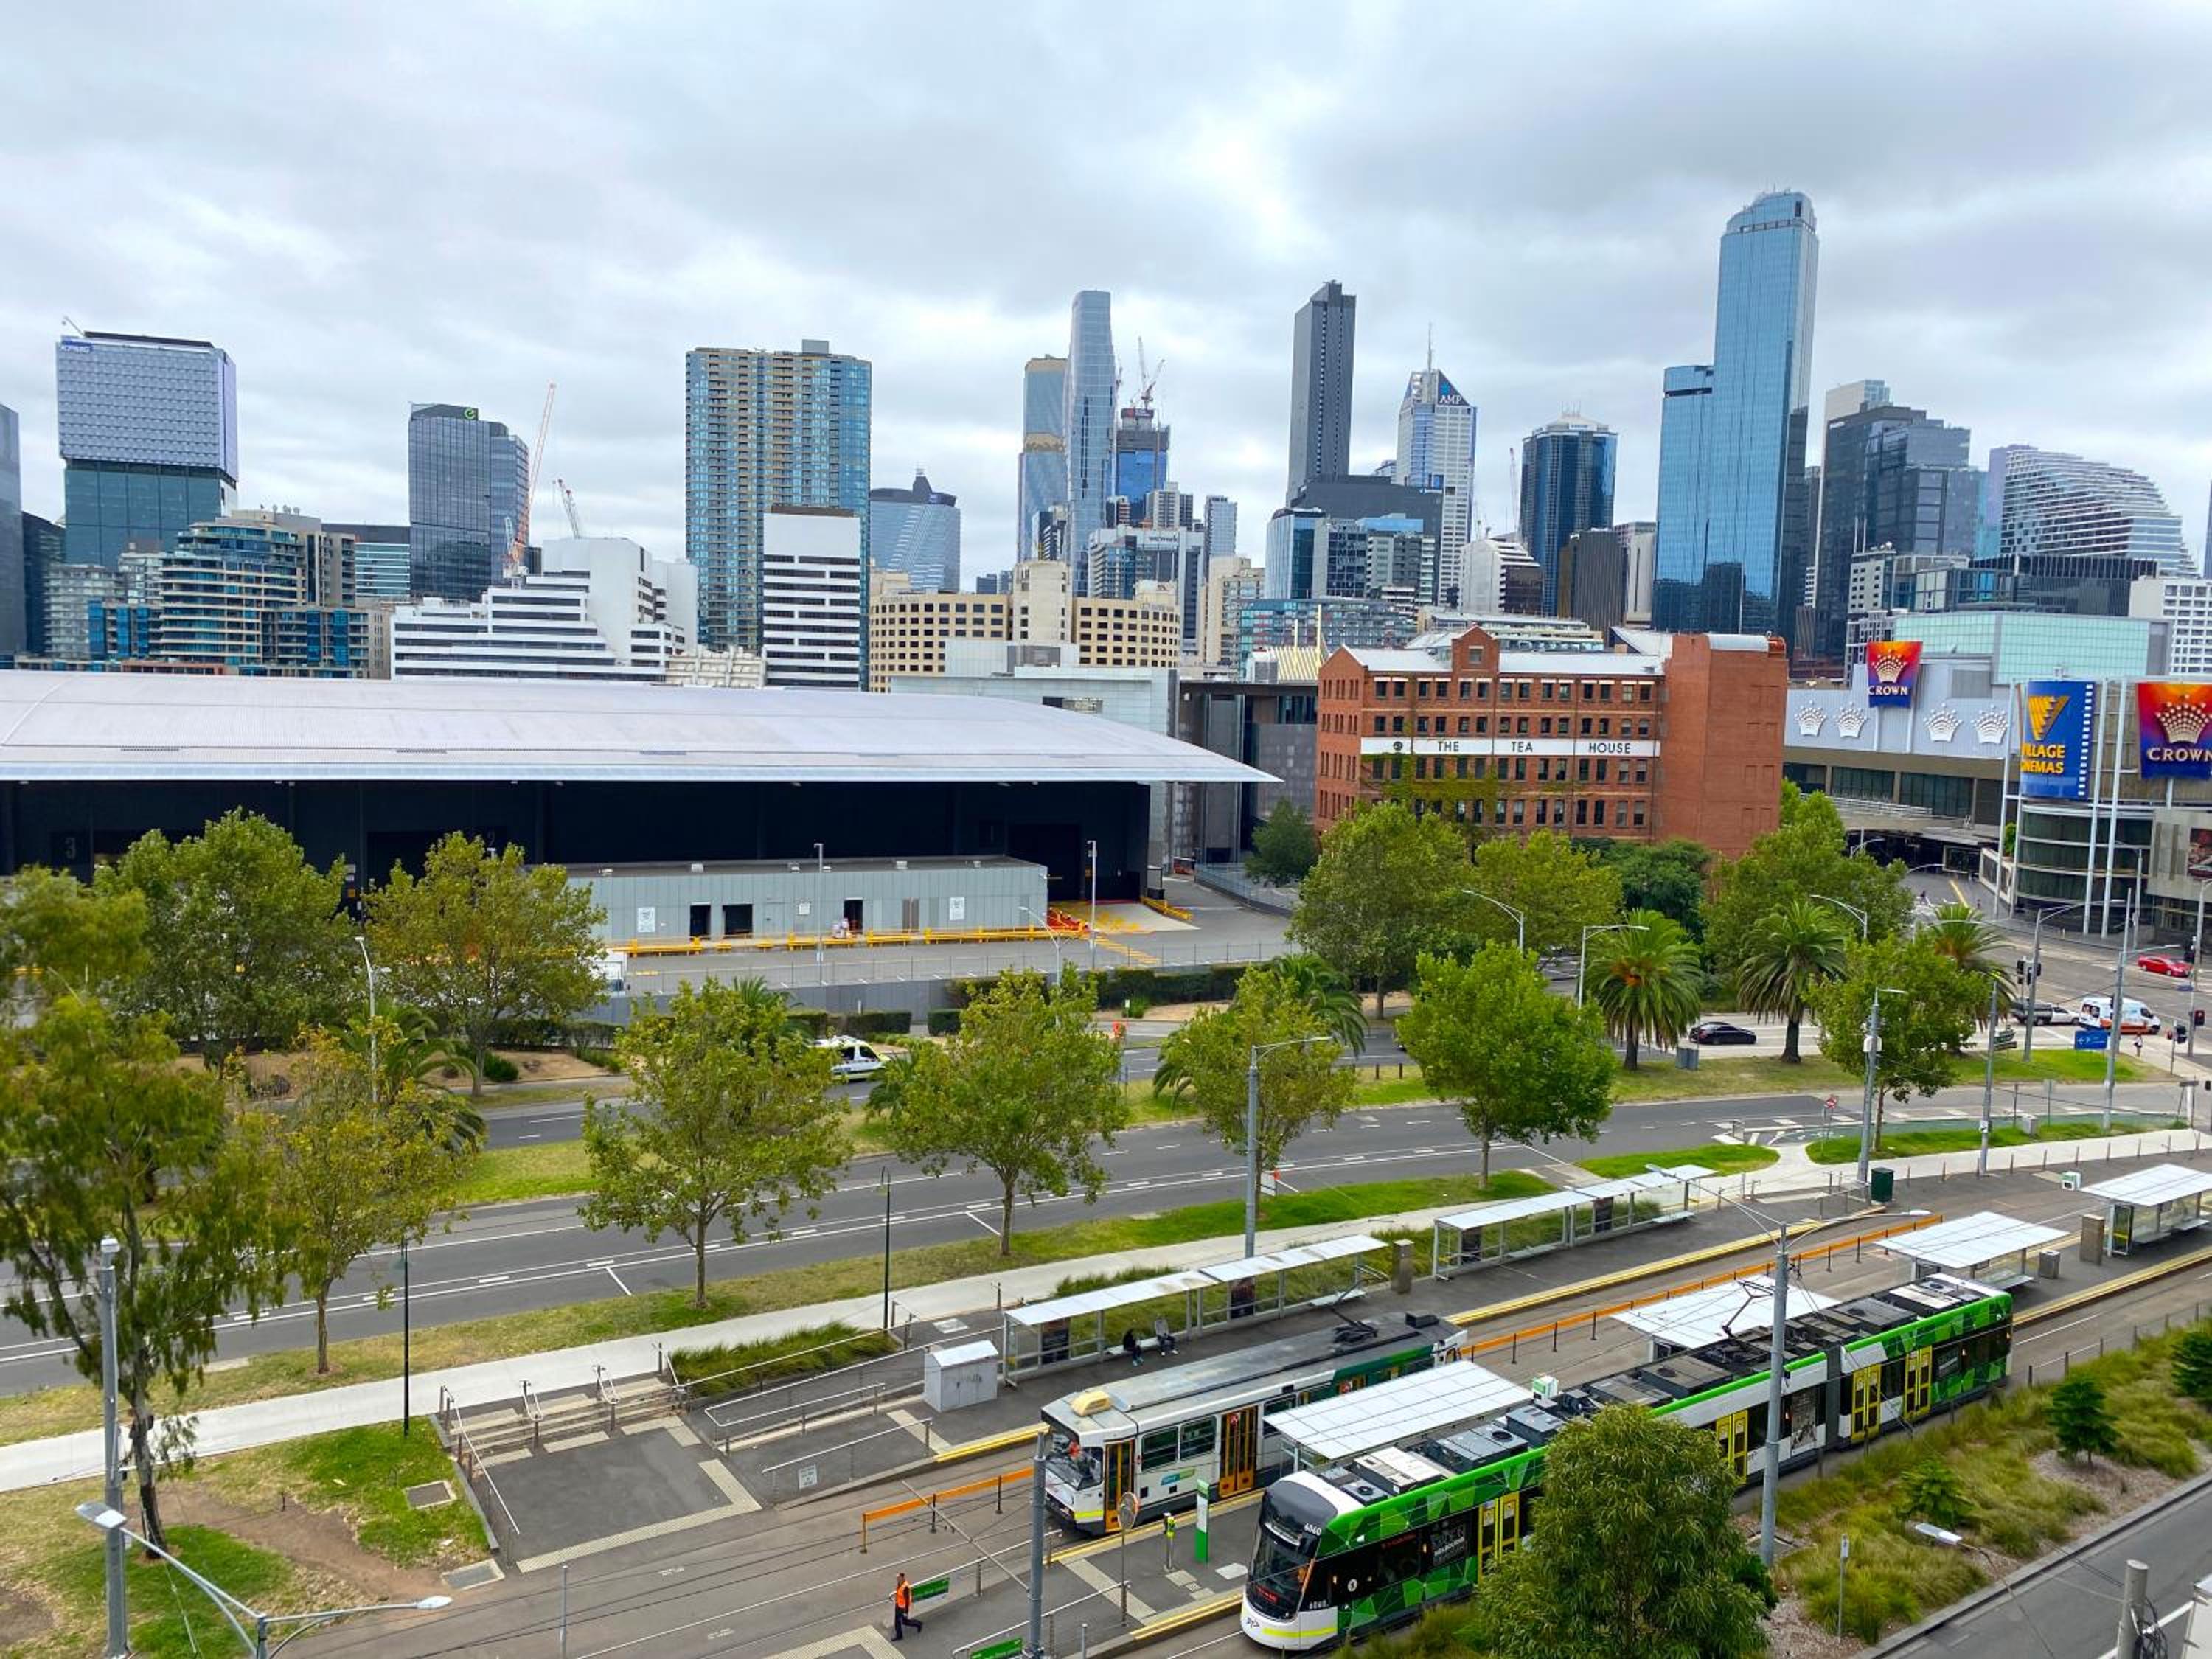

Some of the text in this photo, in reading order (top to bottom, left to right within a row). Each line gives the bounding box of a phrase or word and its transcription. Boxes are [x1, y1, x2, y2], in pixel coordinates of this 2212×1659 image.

[1439, 394, 1461, 404] AMP
[1867, 686, 1908, 695] CROWN
[1437, 740, 1631, 754] THE TEA HOUSE
[65, 837, 77, 861] 3
